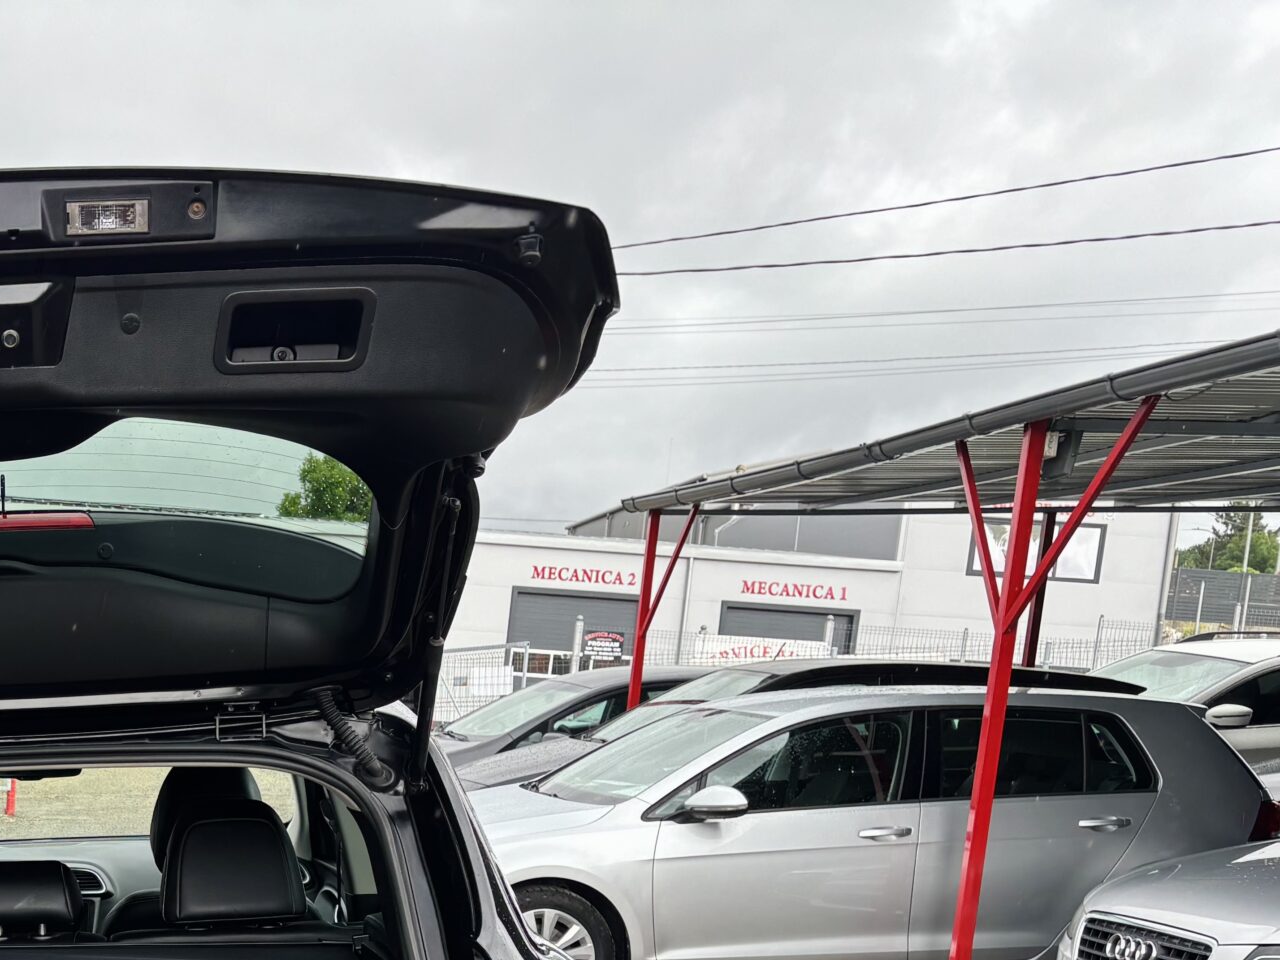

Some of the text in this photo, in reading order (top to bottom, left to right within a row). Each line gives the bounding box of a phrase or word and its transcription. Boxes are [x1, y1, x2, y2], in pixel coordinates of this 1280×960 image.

[531, 565, 636, 586] MECANICA 2
[740, 580, 848, 600] MECANICA 1
